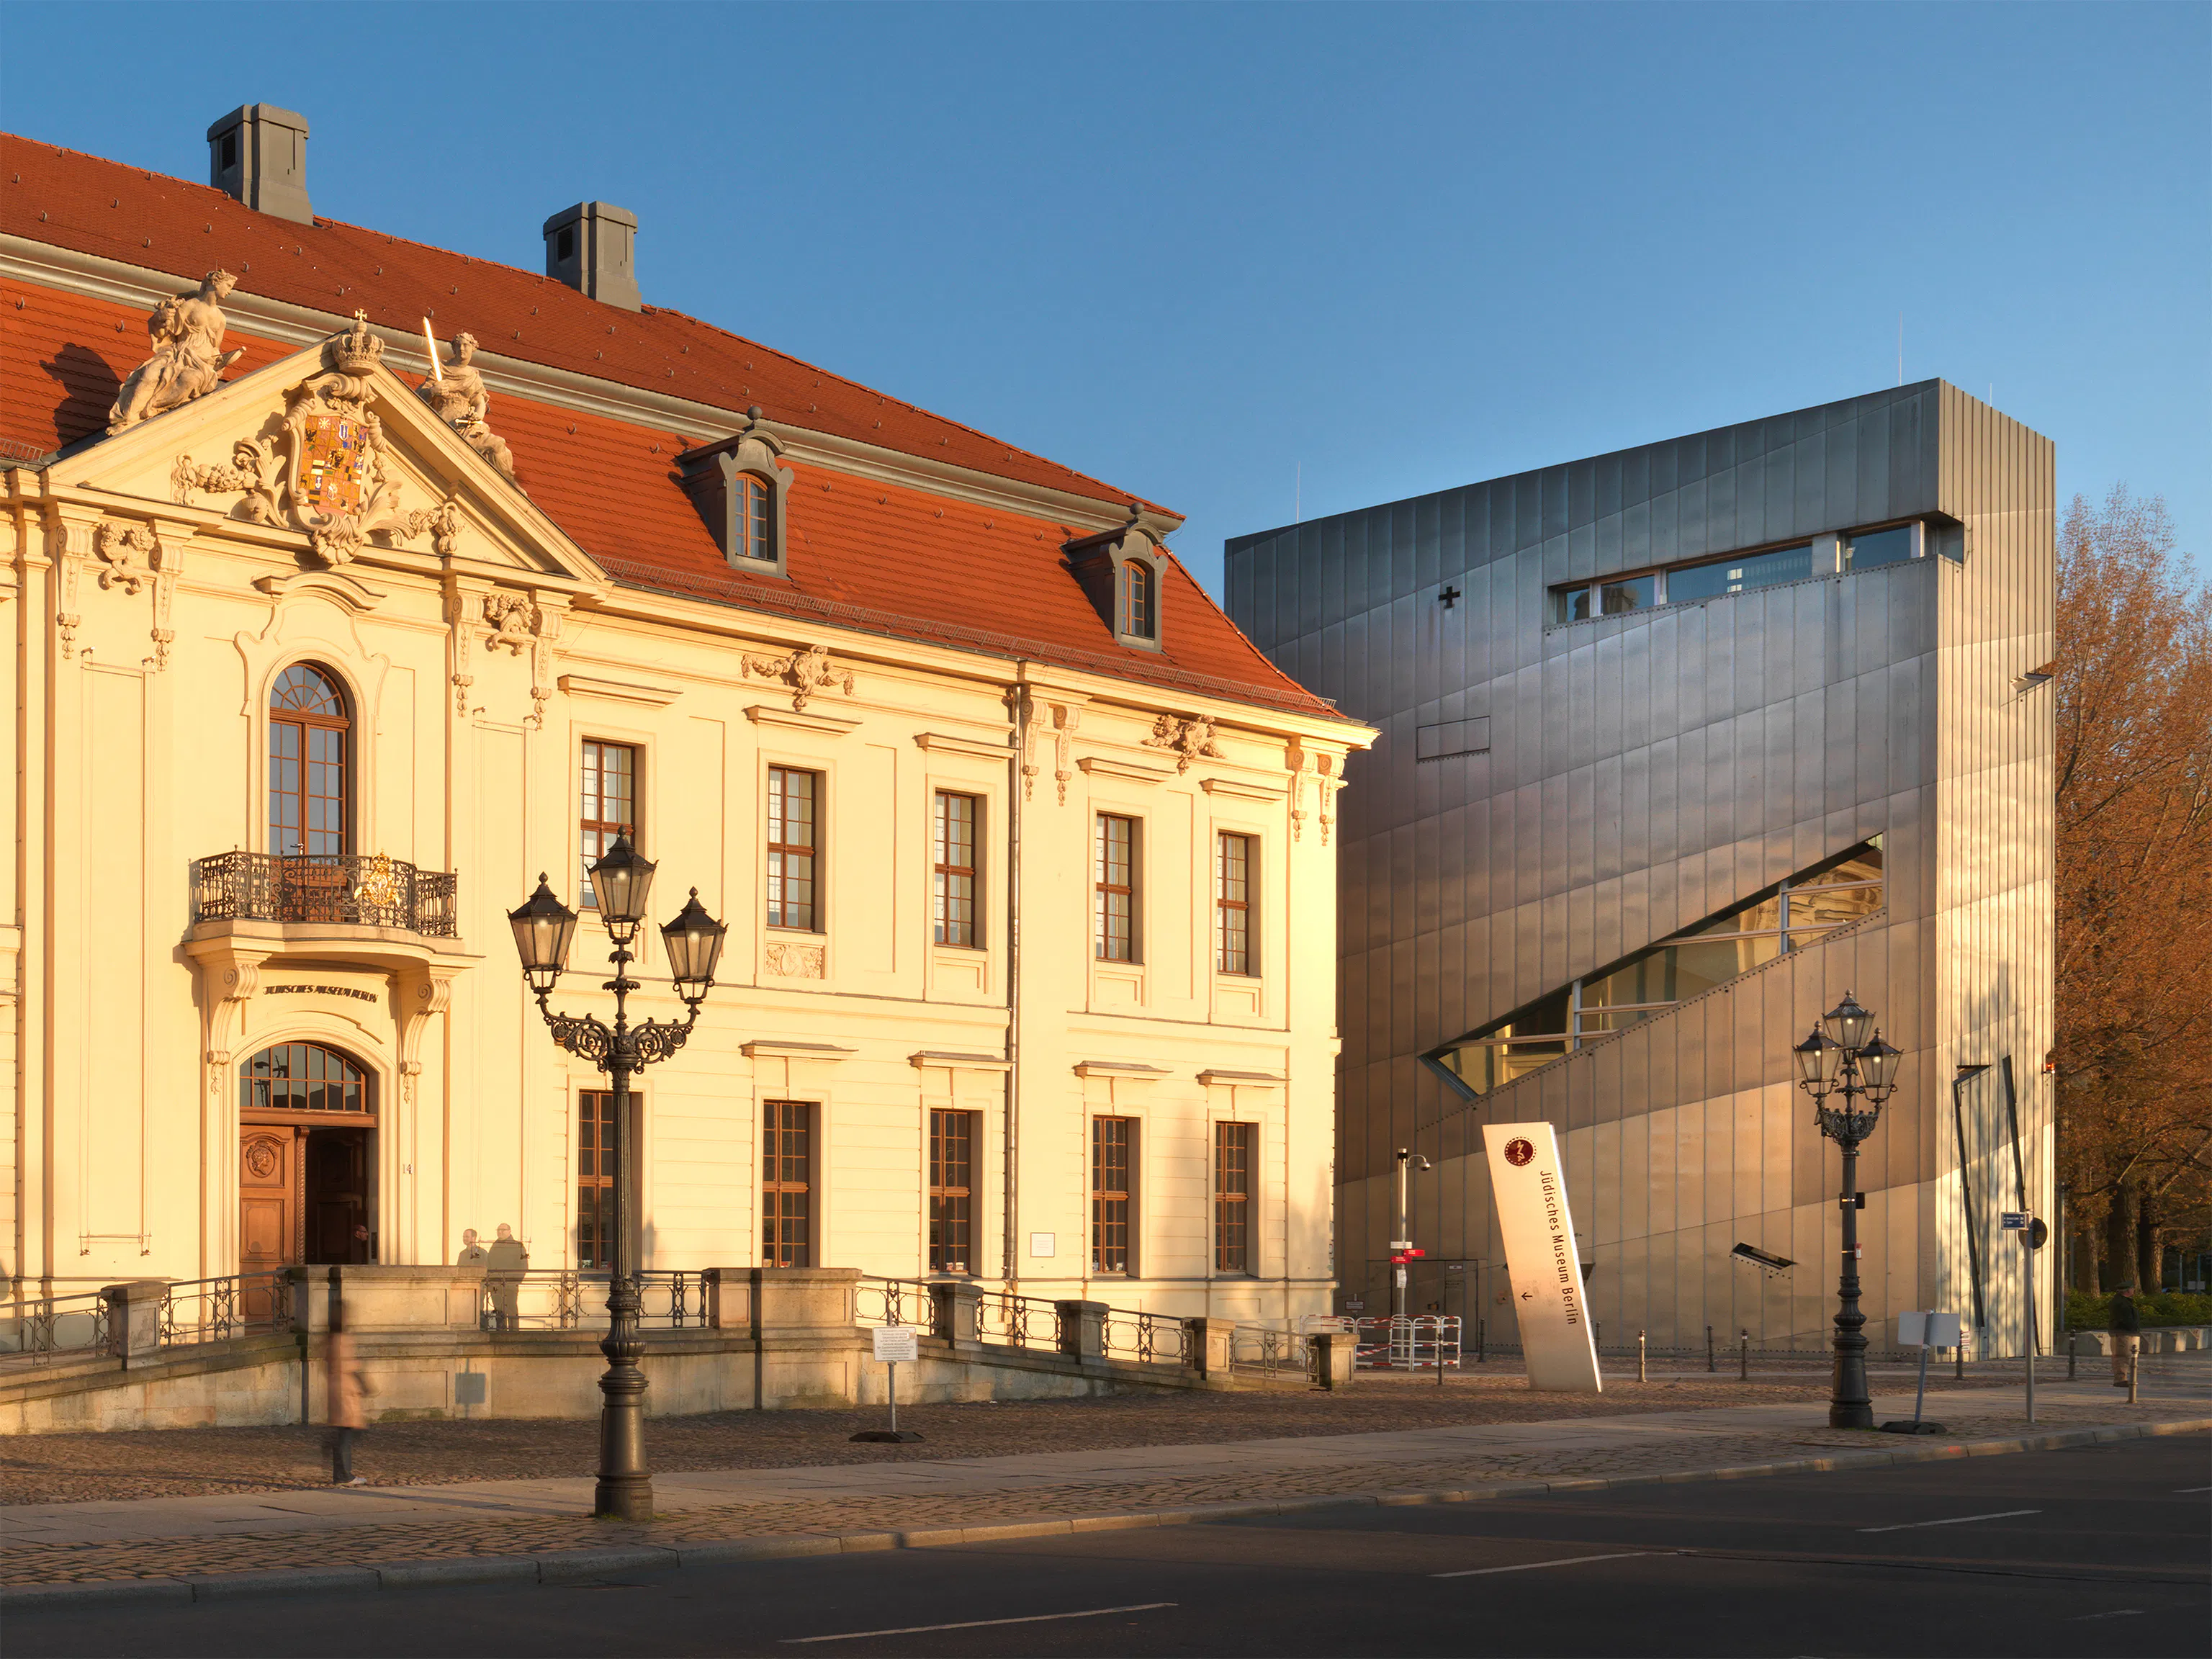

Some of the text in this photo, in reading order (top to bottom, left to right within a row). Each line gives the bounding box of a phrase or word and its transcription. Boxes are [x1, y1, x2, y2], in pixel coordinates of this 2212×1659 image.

[403, 1164, 413, 1174] 14
[1539, 1170, 1578, 1325] Jüdisches Museum Berlin
